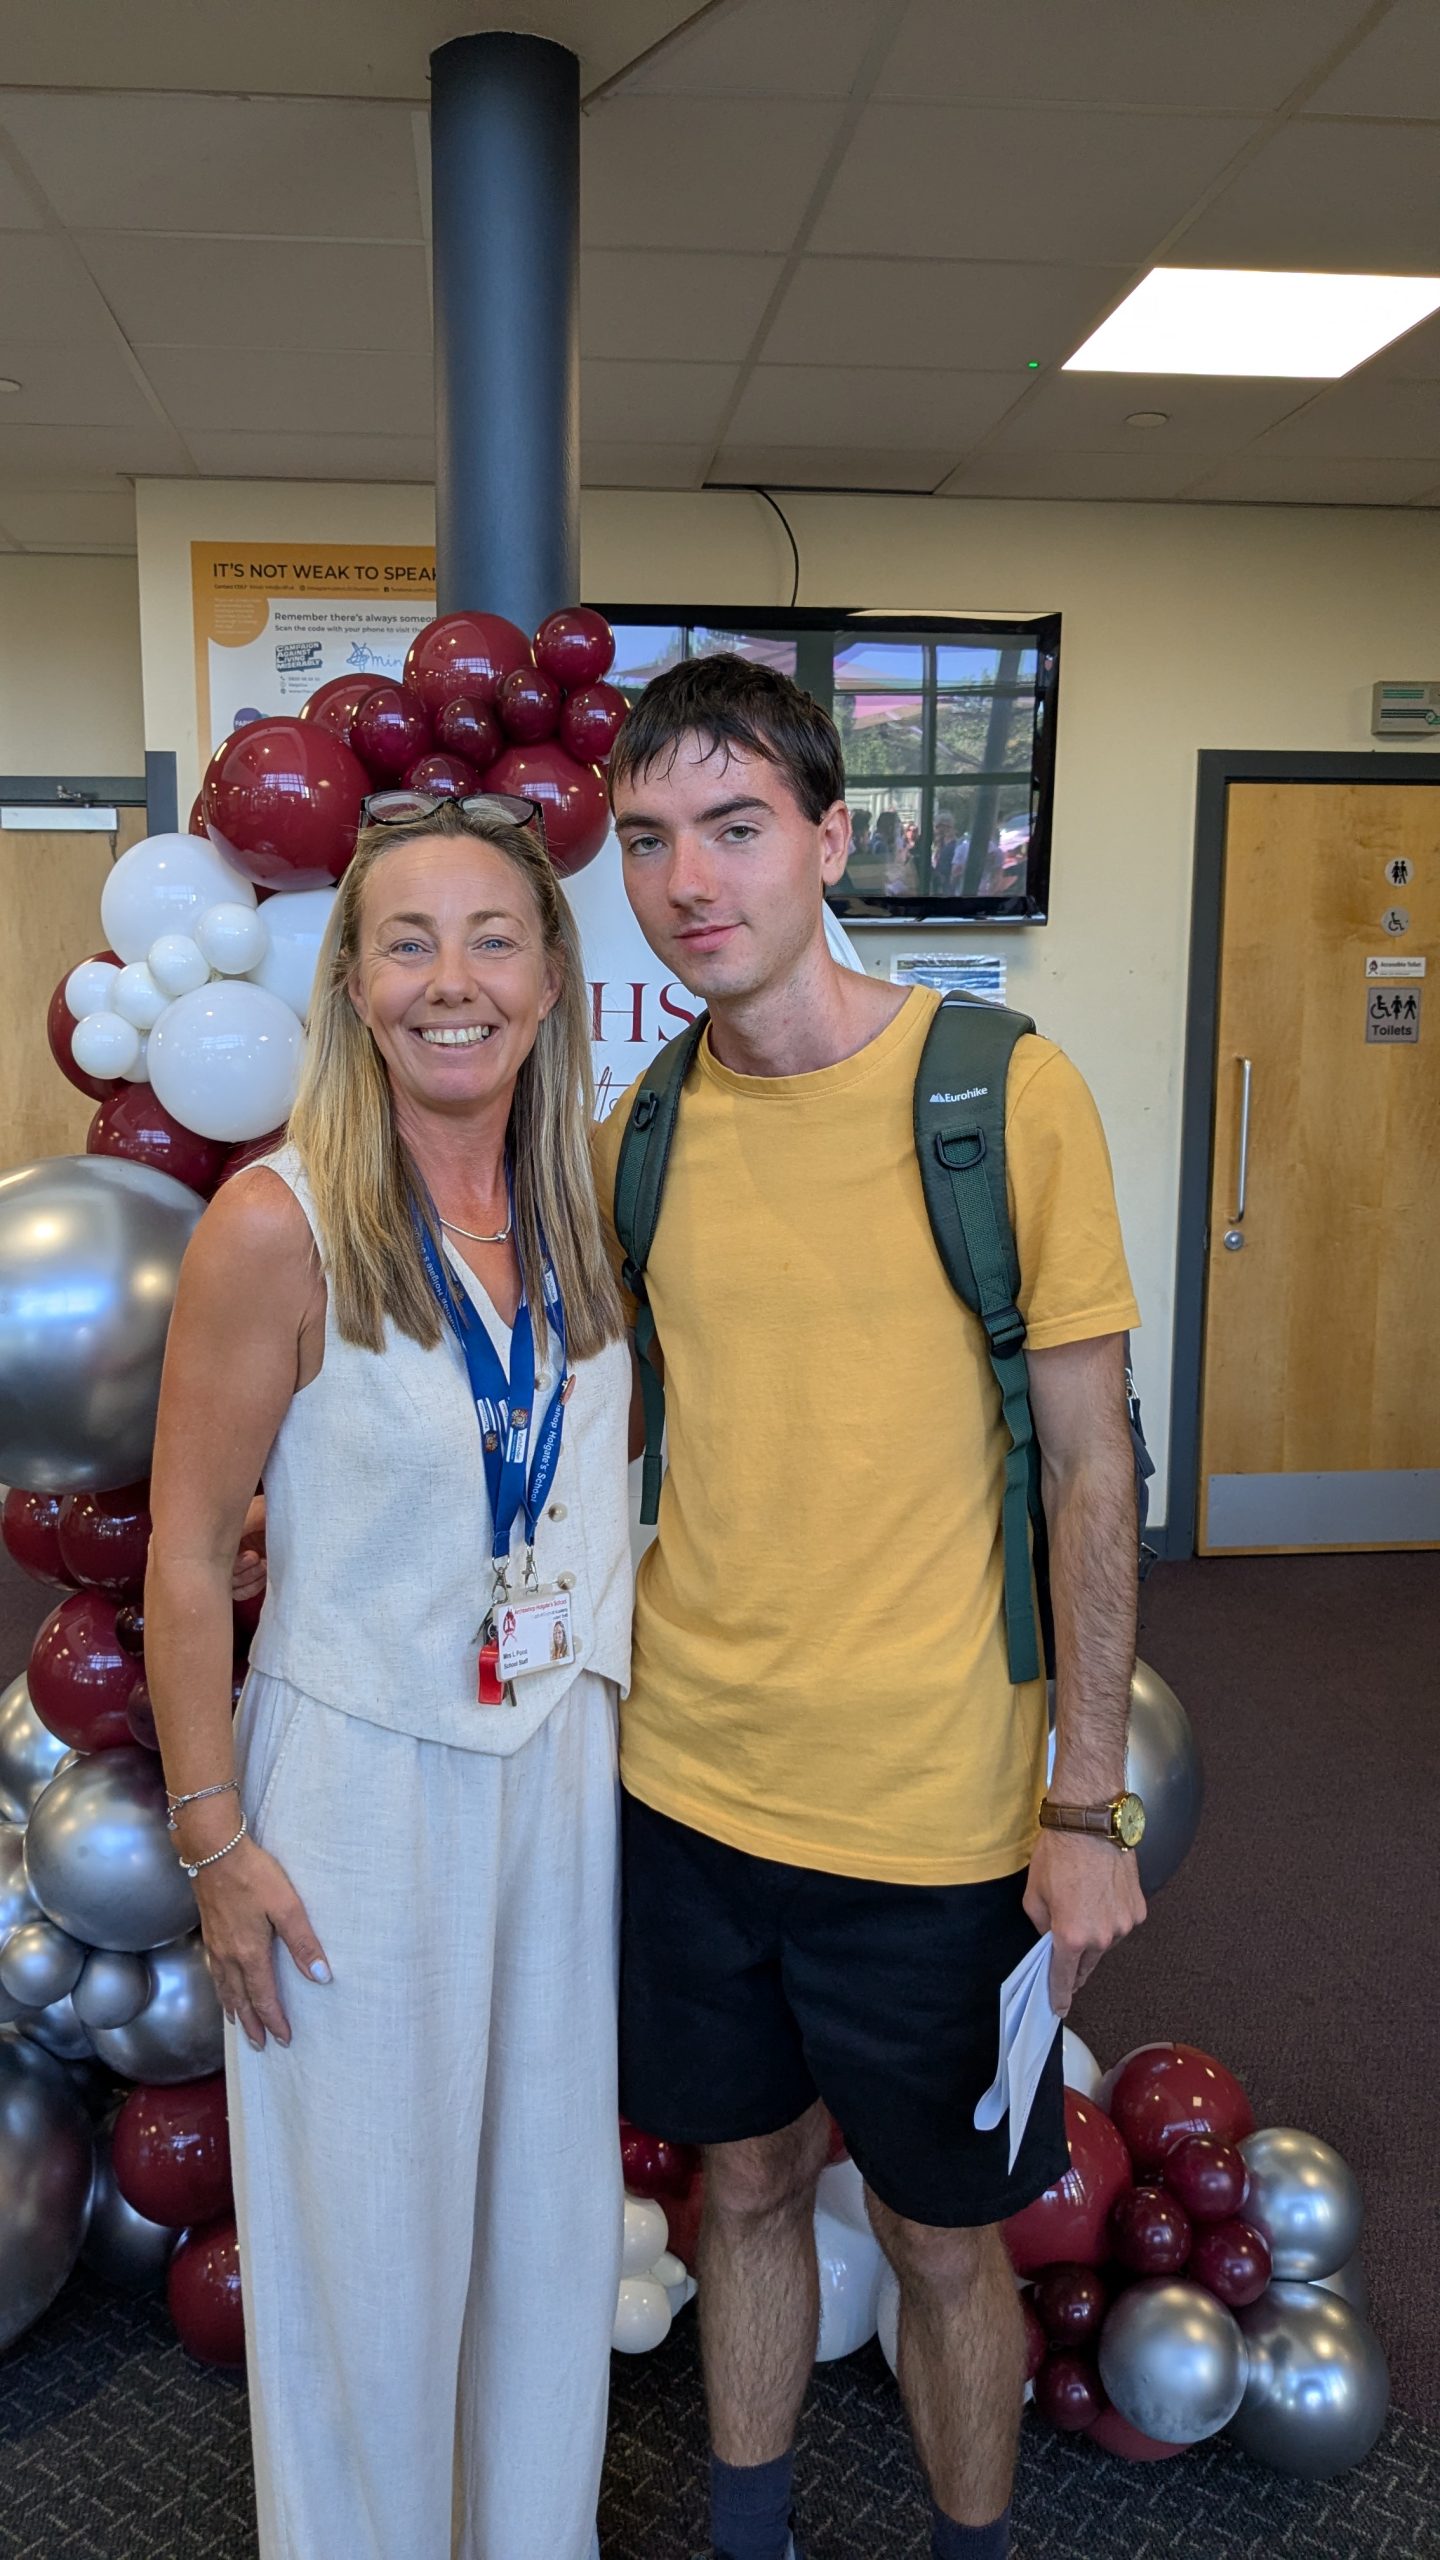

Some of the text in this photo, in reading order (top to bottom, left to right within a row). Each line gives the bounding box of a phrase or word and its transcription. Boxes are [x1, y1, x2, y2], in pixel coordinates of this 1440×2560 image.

[213, 563, 244, 578] IT'S
[250, 564, 288, 578] NOT
[293, 565, 350, 580] WEAK
[354, 566, 379, 580] TO
[275, 612, 328, 621] Remember
[330, 613, 363, 622] there's
[366, 614, 397, 624] always
[1372, 1025, 1412, 1036] Toilets
[945, 1087, 988, 1103] Eurohike
[540, 1431, 557, 1470] Holgate's
[531, 1472, 547, 1502] School
